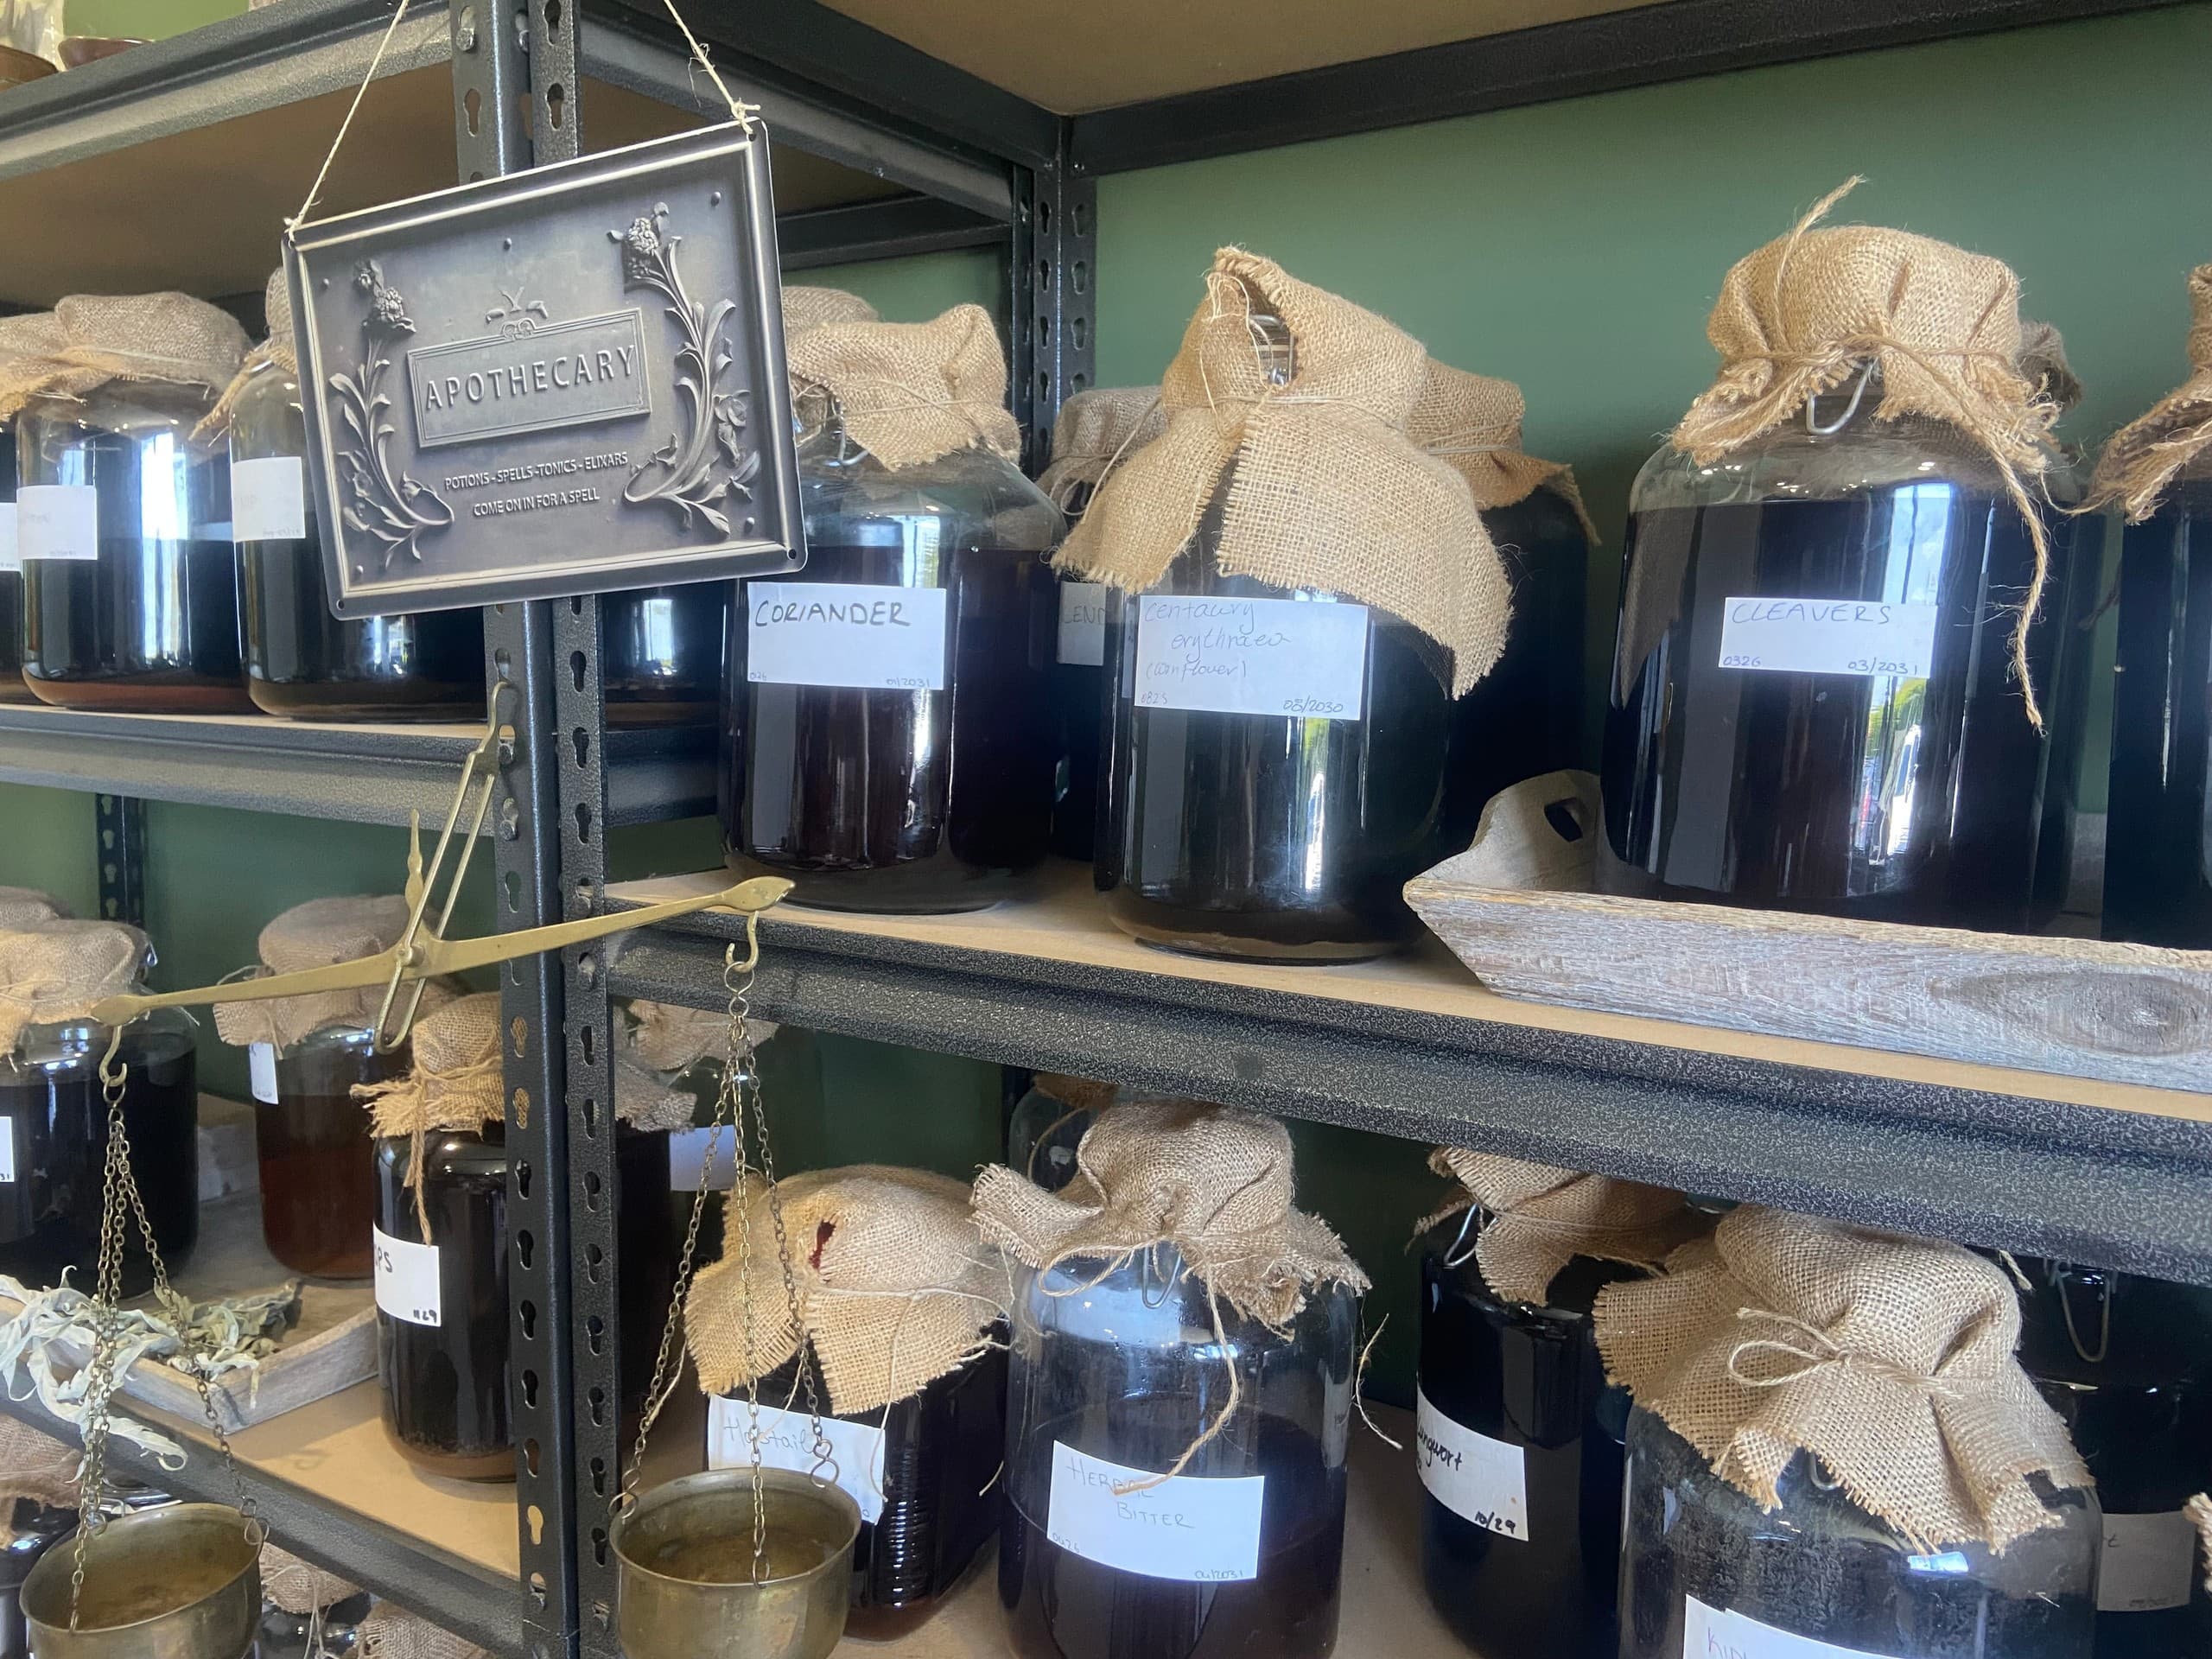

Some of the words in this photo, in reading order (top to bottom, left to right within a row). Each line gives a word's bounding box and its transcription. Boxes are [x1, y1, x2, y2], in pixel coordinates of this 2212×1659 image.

[426, 344, 635, 409] APOTHECARY
[444, 470, 490, 491] POTIONS
[496, 466, 533, 482] SPELLS
[585, 452, 629, 471] ELIXARS
[473, 500, 505, 517] COME
[505, 499, 522, 512] ON
[523, 498, 536, 510] IN
[537, 493, 556, 507] FOR
[556, 492, 568, 505] A
[569, 486, 601, 504] SPELL
[754, 600, 912, 627] CORIANDER
[1732, 601, 1891, 625] CLEAVERS
[1847, 657, 1918, 676] 03/2031
[886, 676, 931, 688] 01/2031
[1116, 1500, 1197, 1529] BITTER
[1474, 1510, 1516, 1535] 10/29
